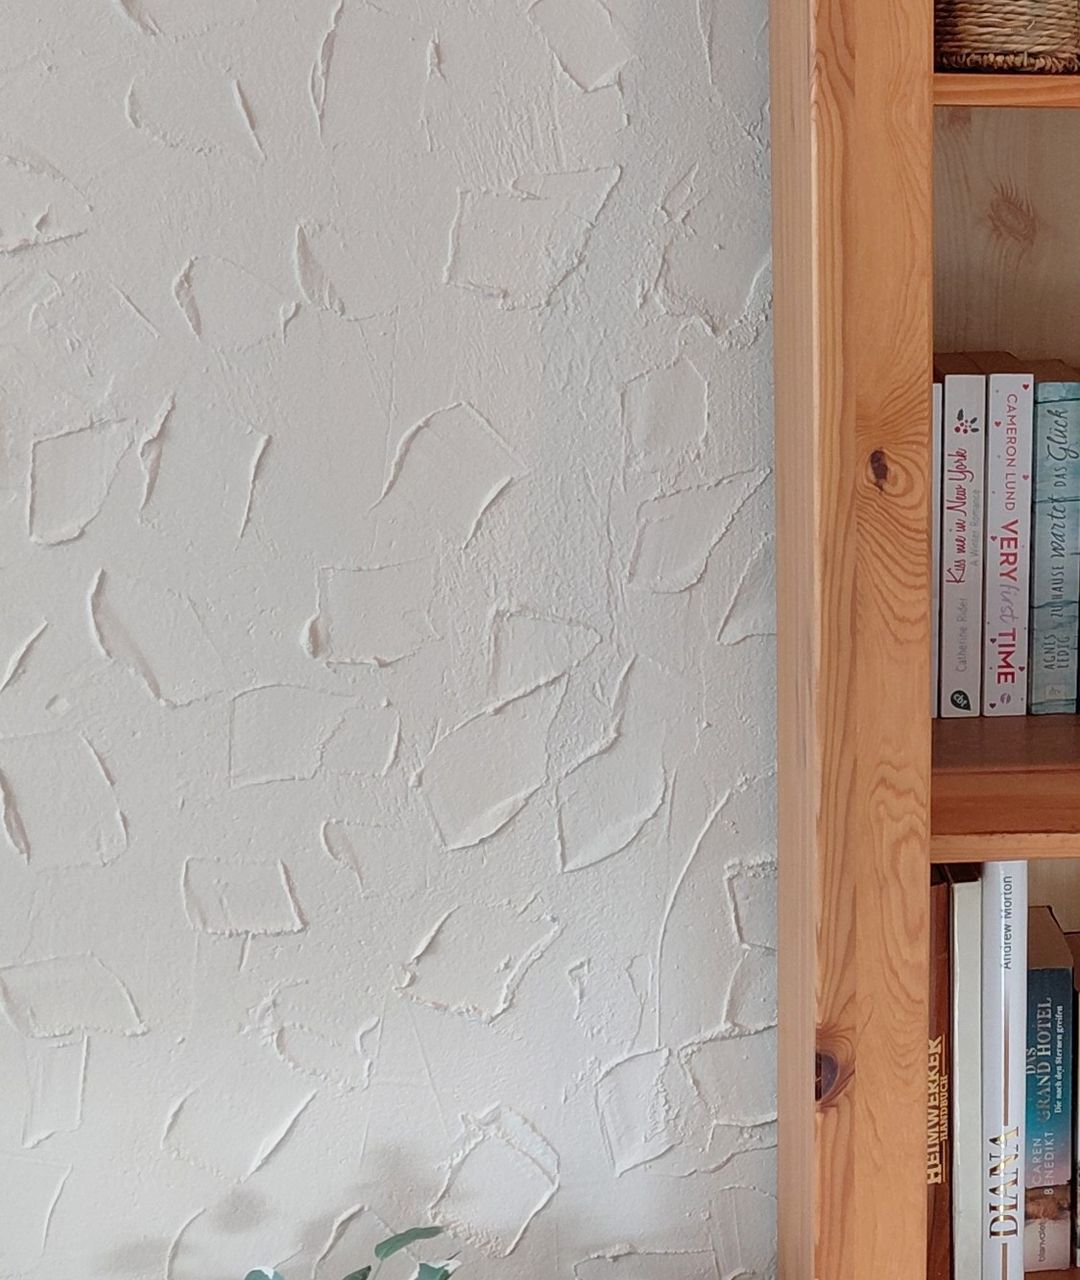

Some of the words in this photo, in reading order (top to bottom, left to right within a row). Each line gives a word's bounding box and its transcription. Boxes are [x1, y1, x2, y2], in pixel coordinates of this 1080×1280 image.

[1006, 393, 1018, 467] CAMERON
[1047, 408, 1079, 461] Glück
[947, 448, 975, 483] York
[1054, 466, 1067, 487] DAS
[946, 484, 967, 517] New
[1004, 472, 1017, 511] LUND
[955, 536, 966, 554] me
[999, 519, 1019, 582] VERY
[946, 558, 966, 583] Kiss
[957, 598, 967, 622] Rider
[1000, 584, 1020, 624] first
[997, 627, 1016, 684] TIME
[1044, 634, 1056, 670] AGNES
[1057, 635, 1070, 669] LEDIG
[1000, 875, 1012, 919] Morton
[1000, 923, 1012, 970] Andrew
[1037, 997, 1052, 1056] HOTEL
[1055, 1005, 1065, 1034] greifen
[1026, 1047, 1036, 1074] DAS
[1055, 1035, 1063, 1065] Sternen
[927, 1035, 942, 1184] HEIMWERKER
[941, 1074, 949, 1141] HANDBUCH
[1036, 1062, 1051, 1121] GRAND
[989, 1126, 1019, 1239] DIANA
[1033, 1138, 1043, 1185] CAREN
[1044, 1131, 1055, 1195] BENEDIKT
